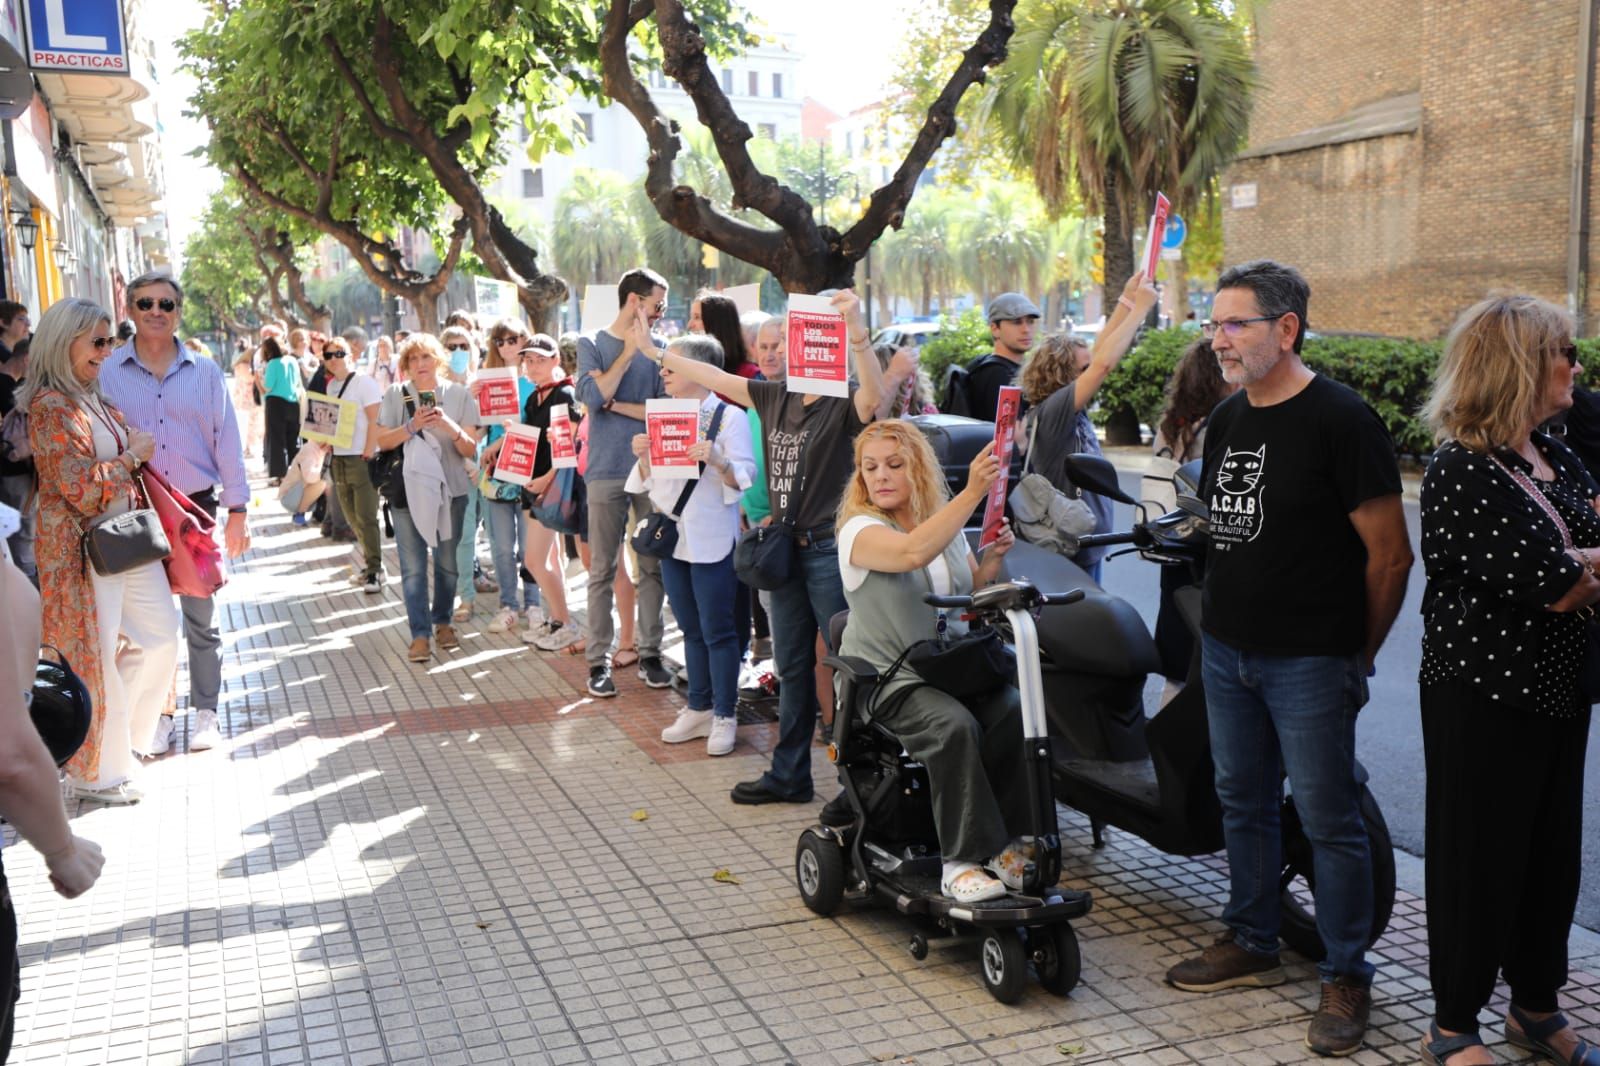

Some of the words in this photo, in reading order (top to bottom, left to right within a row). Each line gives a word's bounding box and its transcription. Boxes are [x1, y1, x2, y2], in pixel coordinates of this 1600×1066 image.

[34, 52, 123, 68] PRACTICAS
[804, 321, 836, 329] TODOS
[771, 461, 781, 476] IS
[780, 494, 788, 508] B
[1211, 494, 1255, 514] A.C.A.B
[1209, 513, 1224, 524] ALL
[1228, 514, 1254, 527] CATS
[1217, 525, 1252, 535] BEAUTIFUL
